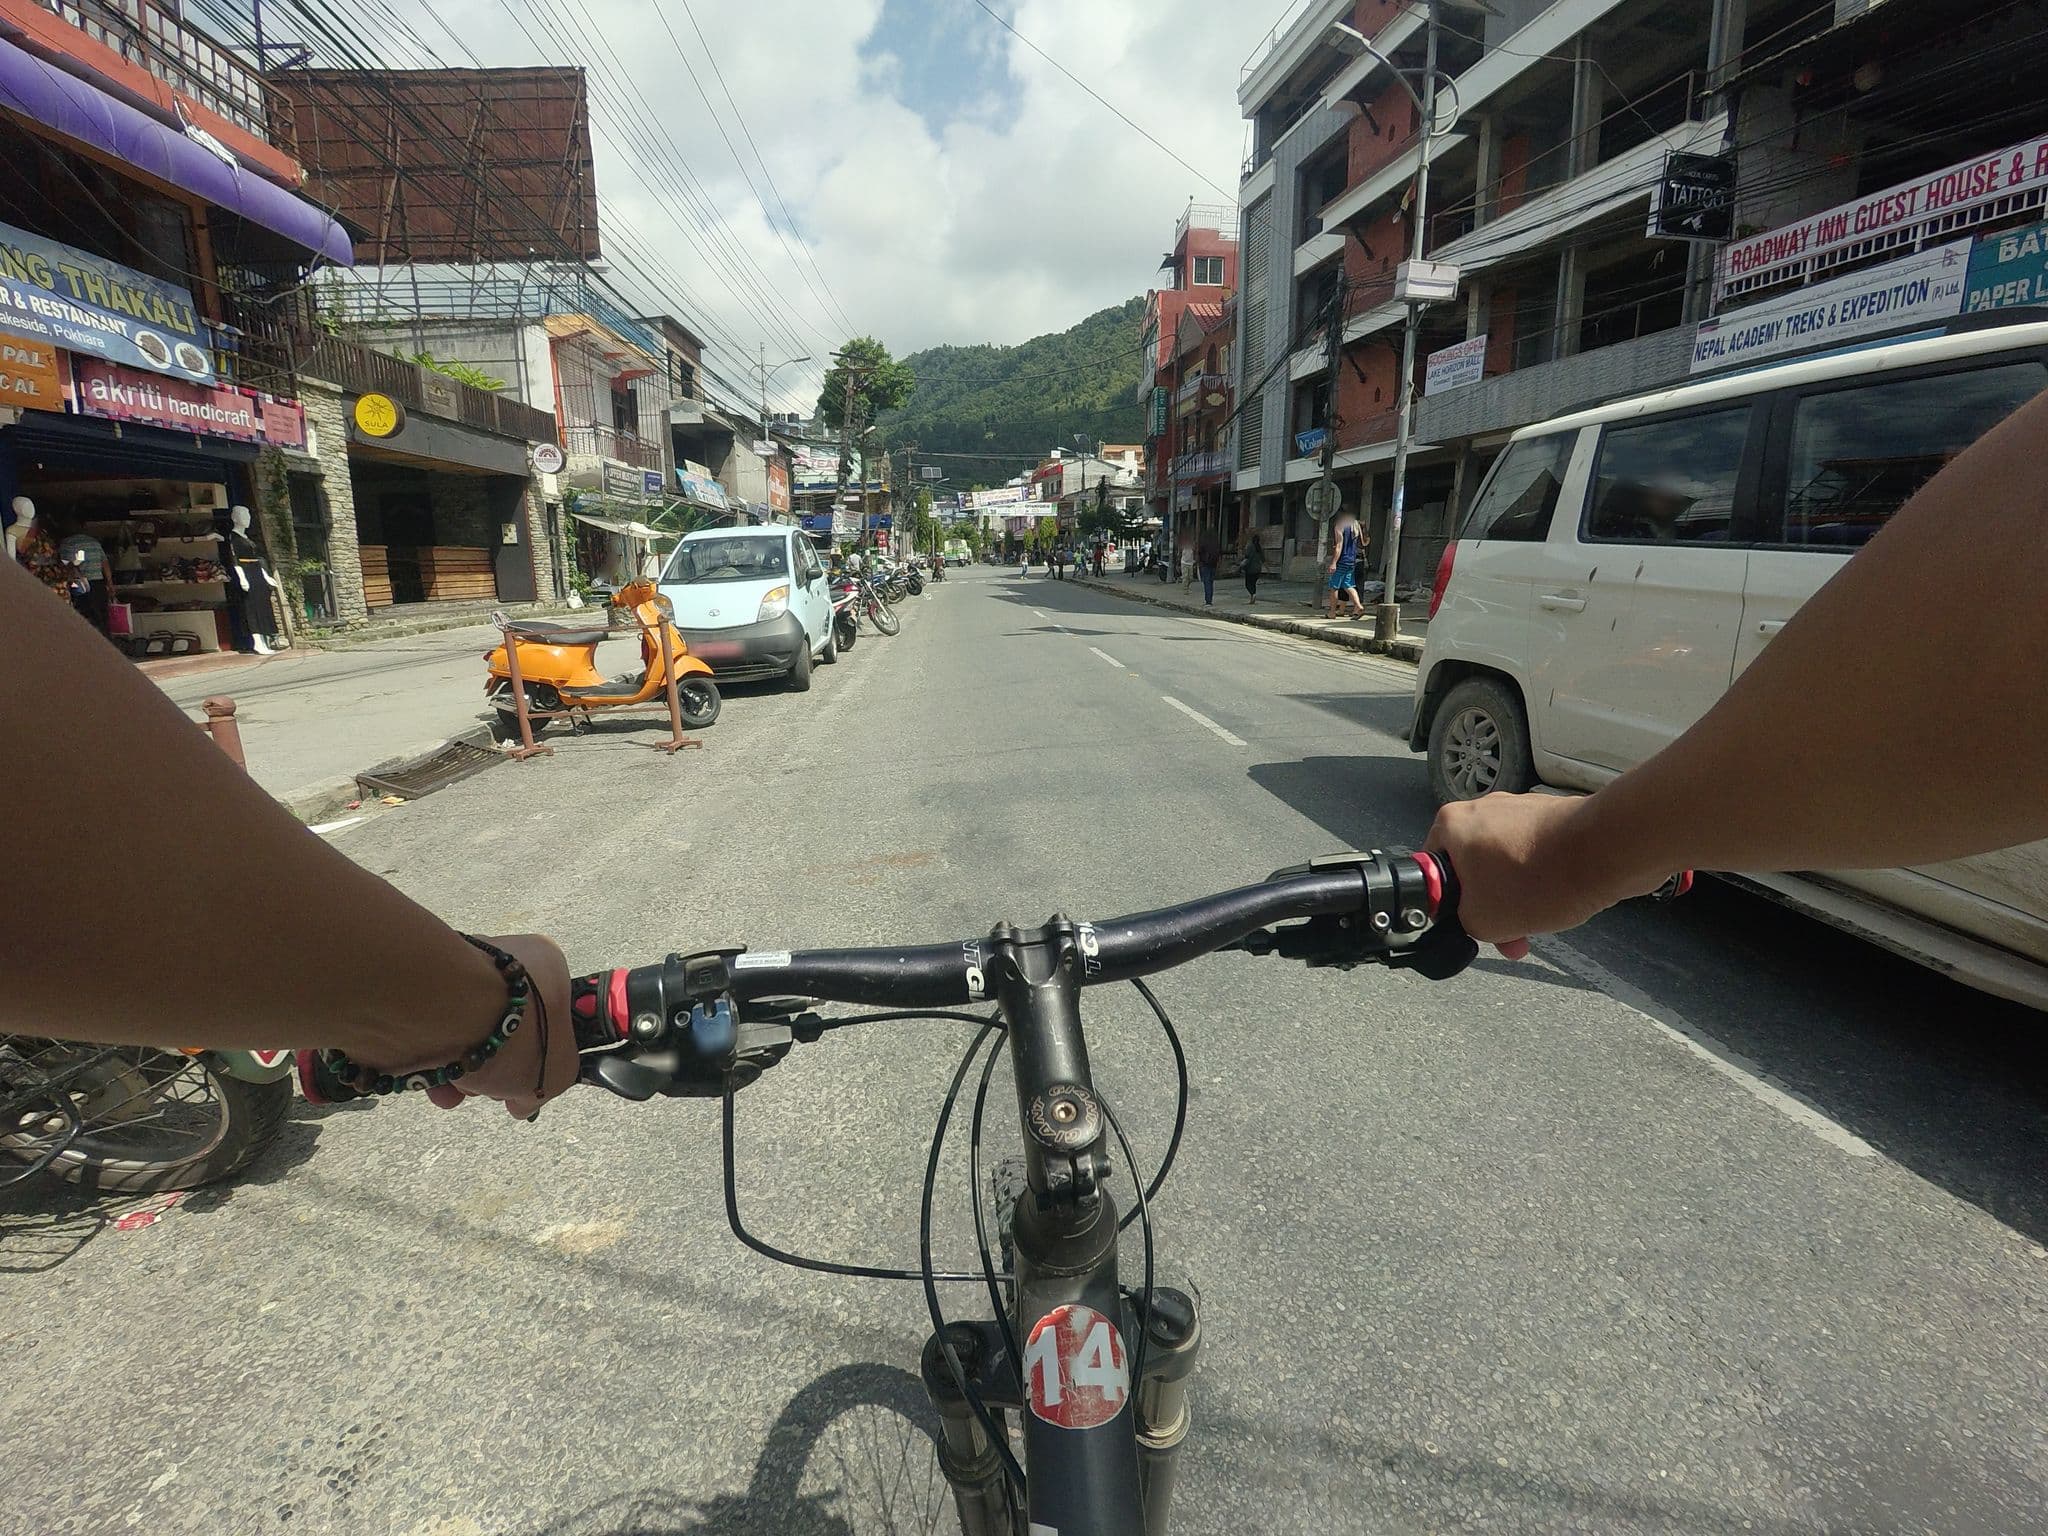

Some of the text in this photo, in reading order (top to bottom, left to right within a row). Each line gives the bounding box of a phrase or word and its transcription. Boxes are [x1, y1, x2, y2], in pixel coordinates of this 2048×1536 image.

[1670, 181, 1726, 209] TATTOO
[1731, 224, 1812, 275] ROADWAY
[1815, 211, 1849, 247] INN
[1854, 185, 1920, 235] GUEST
[1924, 159, 2002, 212] HOUSE
[2007, 151, 2025, 187] &
[13, 289, 28, 310] &
[28, 294, 128, 338] RESTAURANT
[57, 261, 197, 336] THAKALI
[1692, 341, 1726, 364] NEPAL
[1728, 319, 1784, 354] ACADEMY
[1785, 306, 1825, 339] TREKS
[1827, 303, 1837, 326] &
[1839, 276, 1931, 322] EXPEDITION
[1967, 277, 2031, 315] PAPER
[53, 323, 106, 349] Pokhara
[91, 374, 164, 412] akriti
[168, 393, 253, 428] handicraft
[1031, 1095, 1083, 1144] GIANT
[1027, 1320, 1123, 1408] 14
